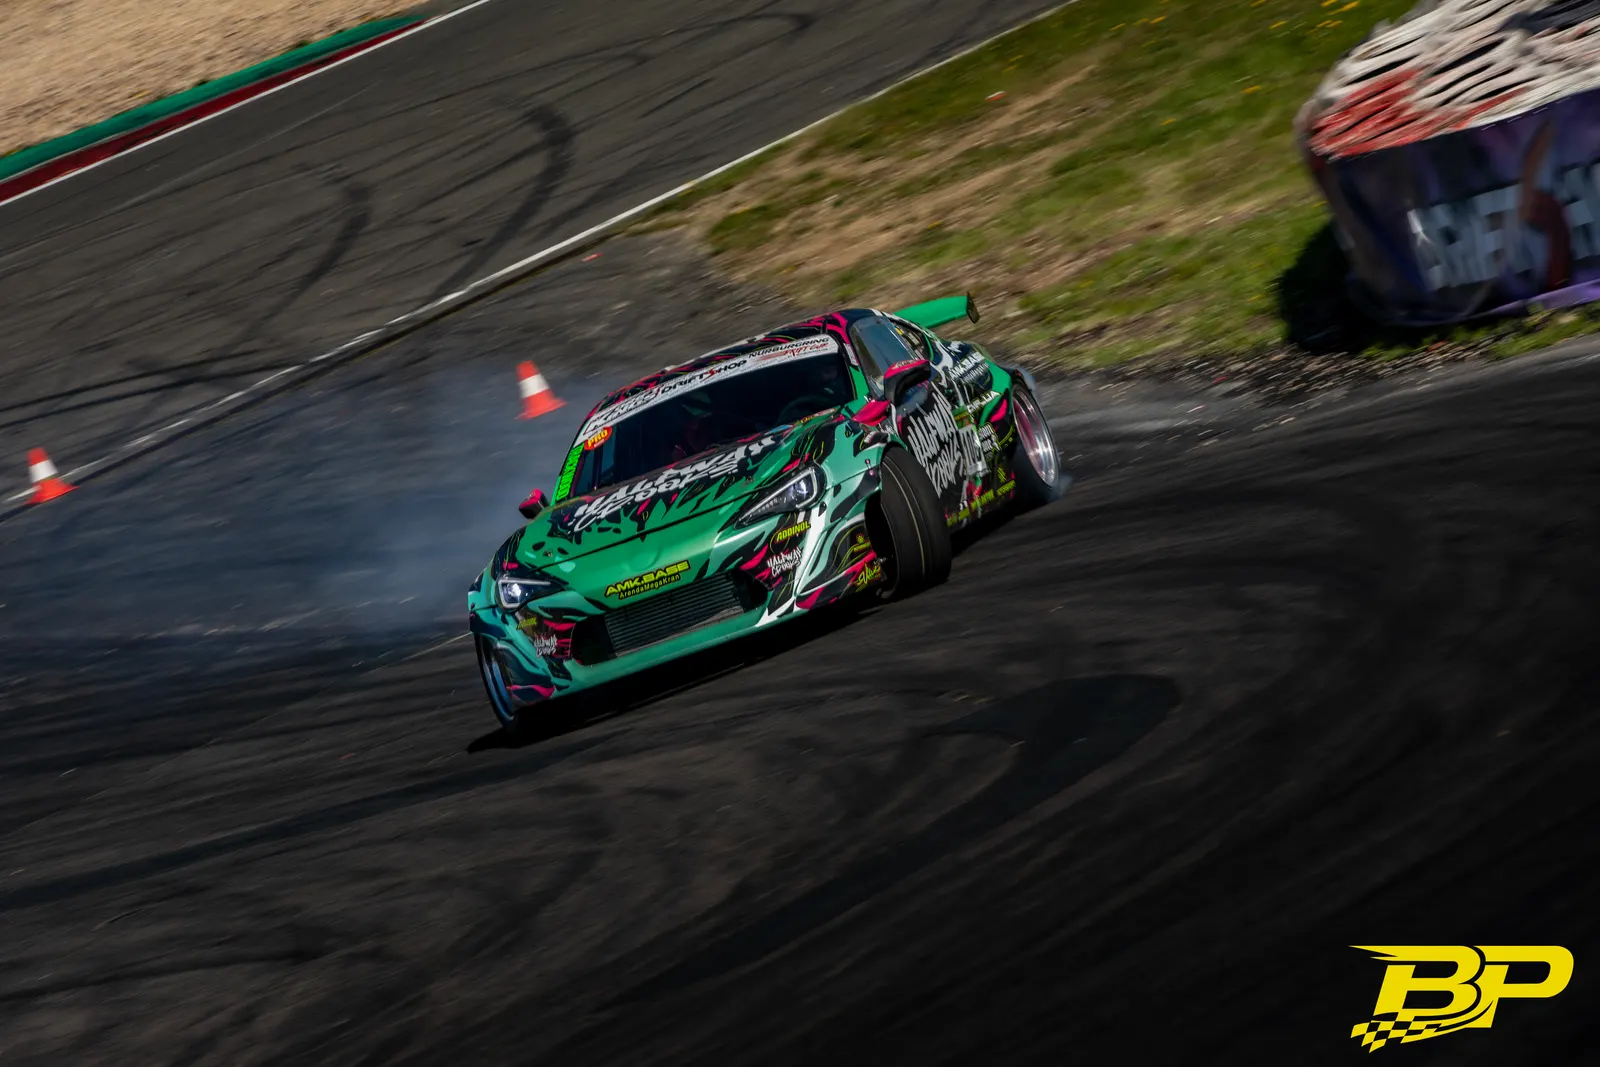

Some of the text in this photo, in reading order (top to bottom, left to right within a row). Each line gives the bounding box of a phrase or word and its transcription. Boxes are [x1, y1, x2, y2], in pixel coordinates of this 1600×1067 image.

[587, 429, 609, 448] PRO
[574, 435, 776, 518] HALFWAY
[775, 521, 811, 543] ADDINOL
[605, 560, 691, 597] AMK.BASE
